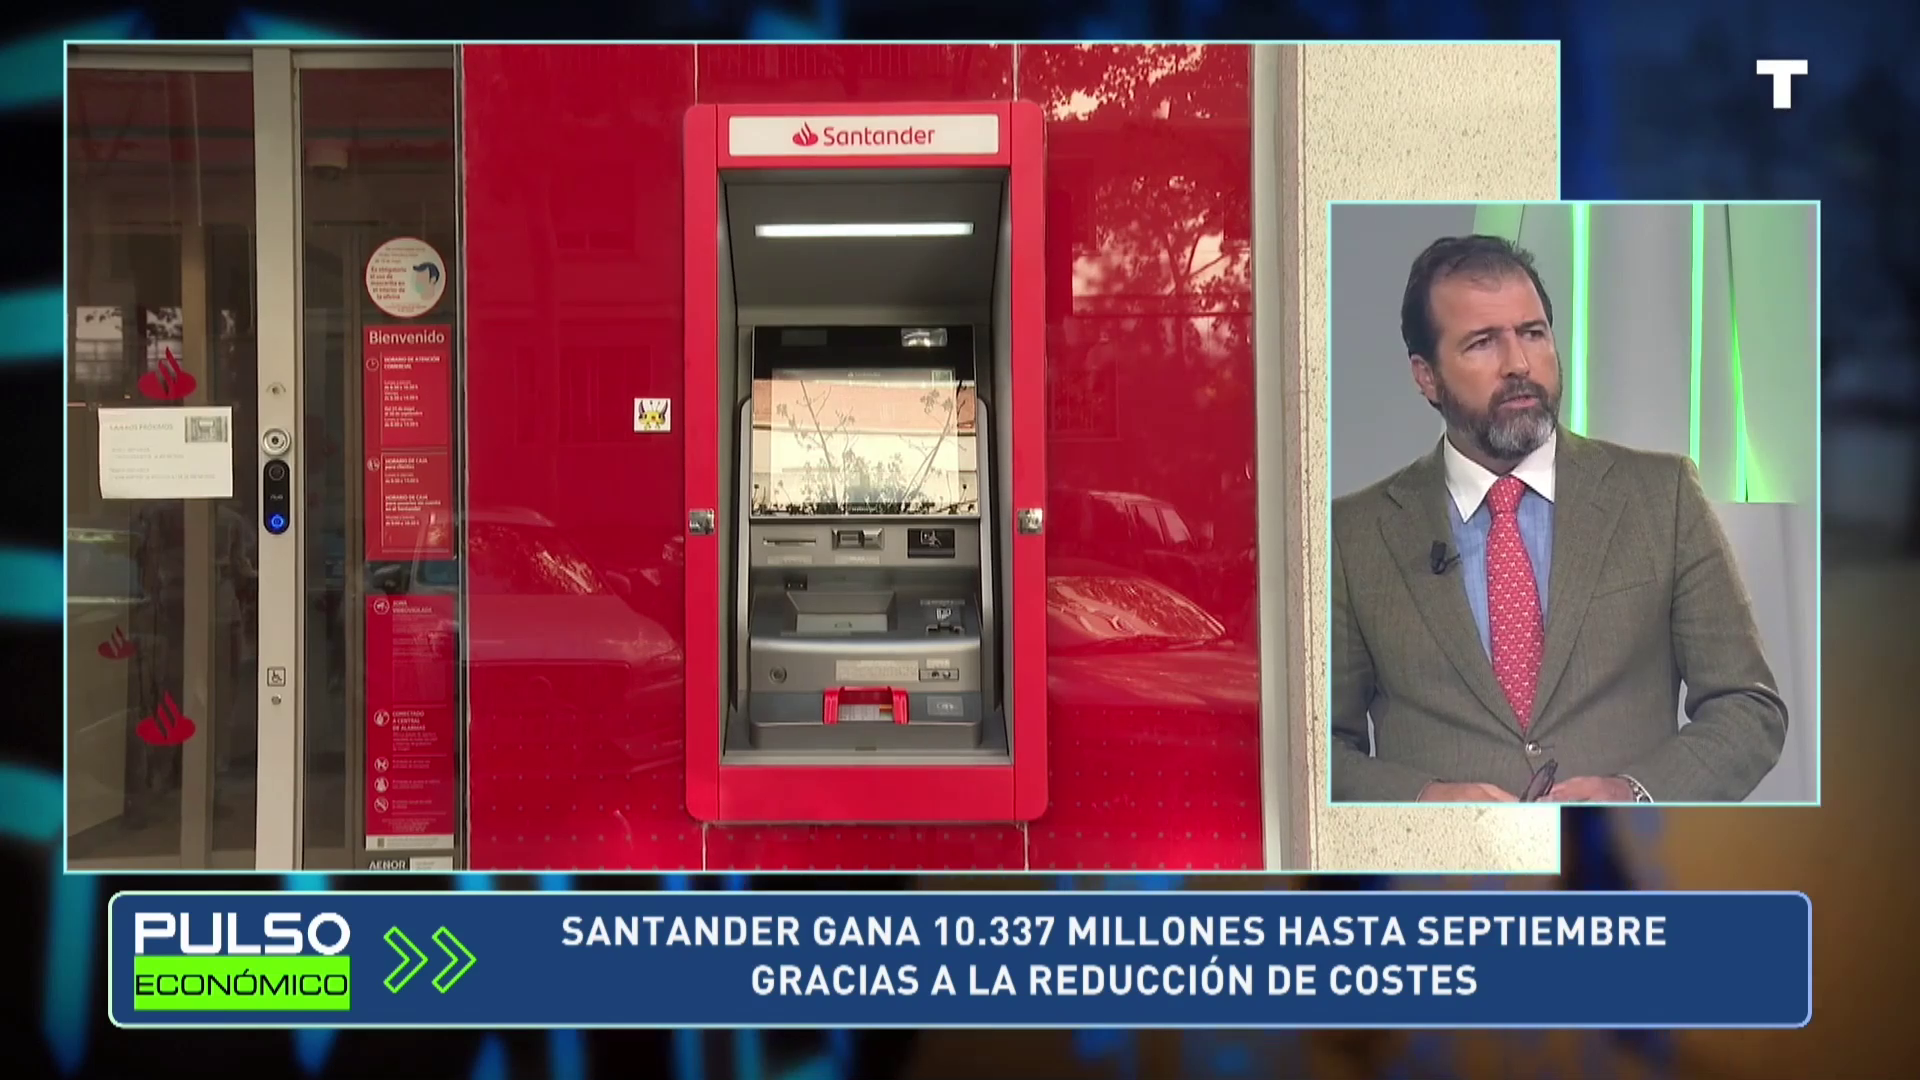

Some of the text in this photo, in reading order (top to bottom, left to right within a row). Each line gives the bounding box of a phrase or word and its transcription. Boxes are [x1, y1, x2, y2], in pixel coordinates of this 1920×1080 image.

[823, 126, 935, 147] Santander
[369, 330, 445, 345] Bienvenido
[369, 860, 407, 870] AENOR
